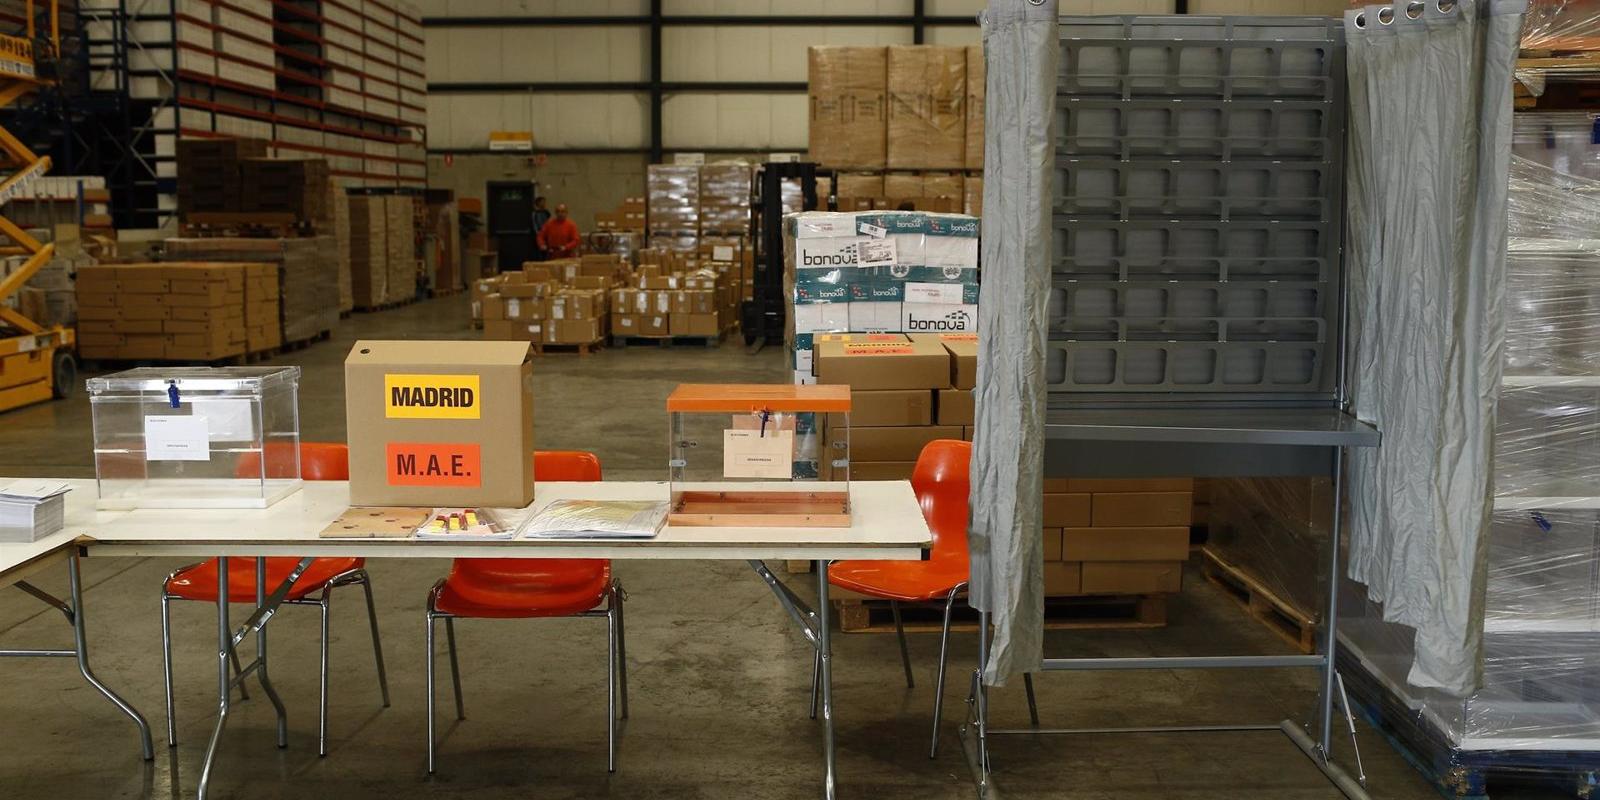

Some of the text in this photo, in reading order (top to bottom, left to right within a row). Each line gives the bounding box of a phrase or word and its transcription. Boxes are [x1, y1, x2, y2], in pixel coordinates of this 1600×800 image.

[897, 219, 921, 228] bonova
[950, 223, 975, 232] bonova
[819, 289, 844, 298] bonova
[909, 312, 965, 330] bonova
[391, 386, 474, 408] MADRID
[396, 453, 472, 477] M.A.E.
